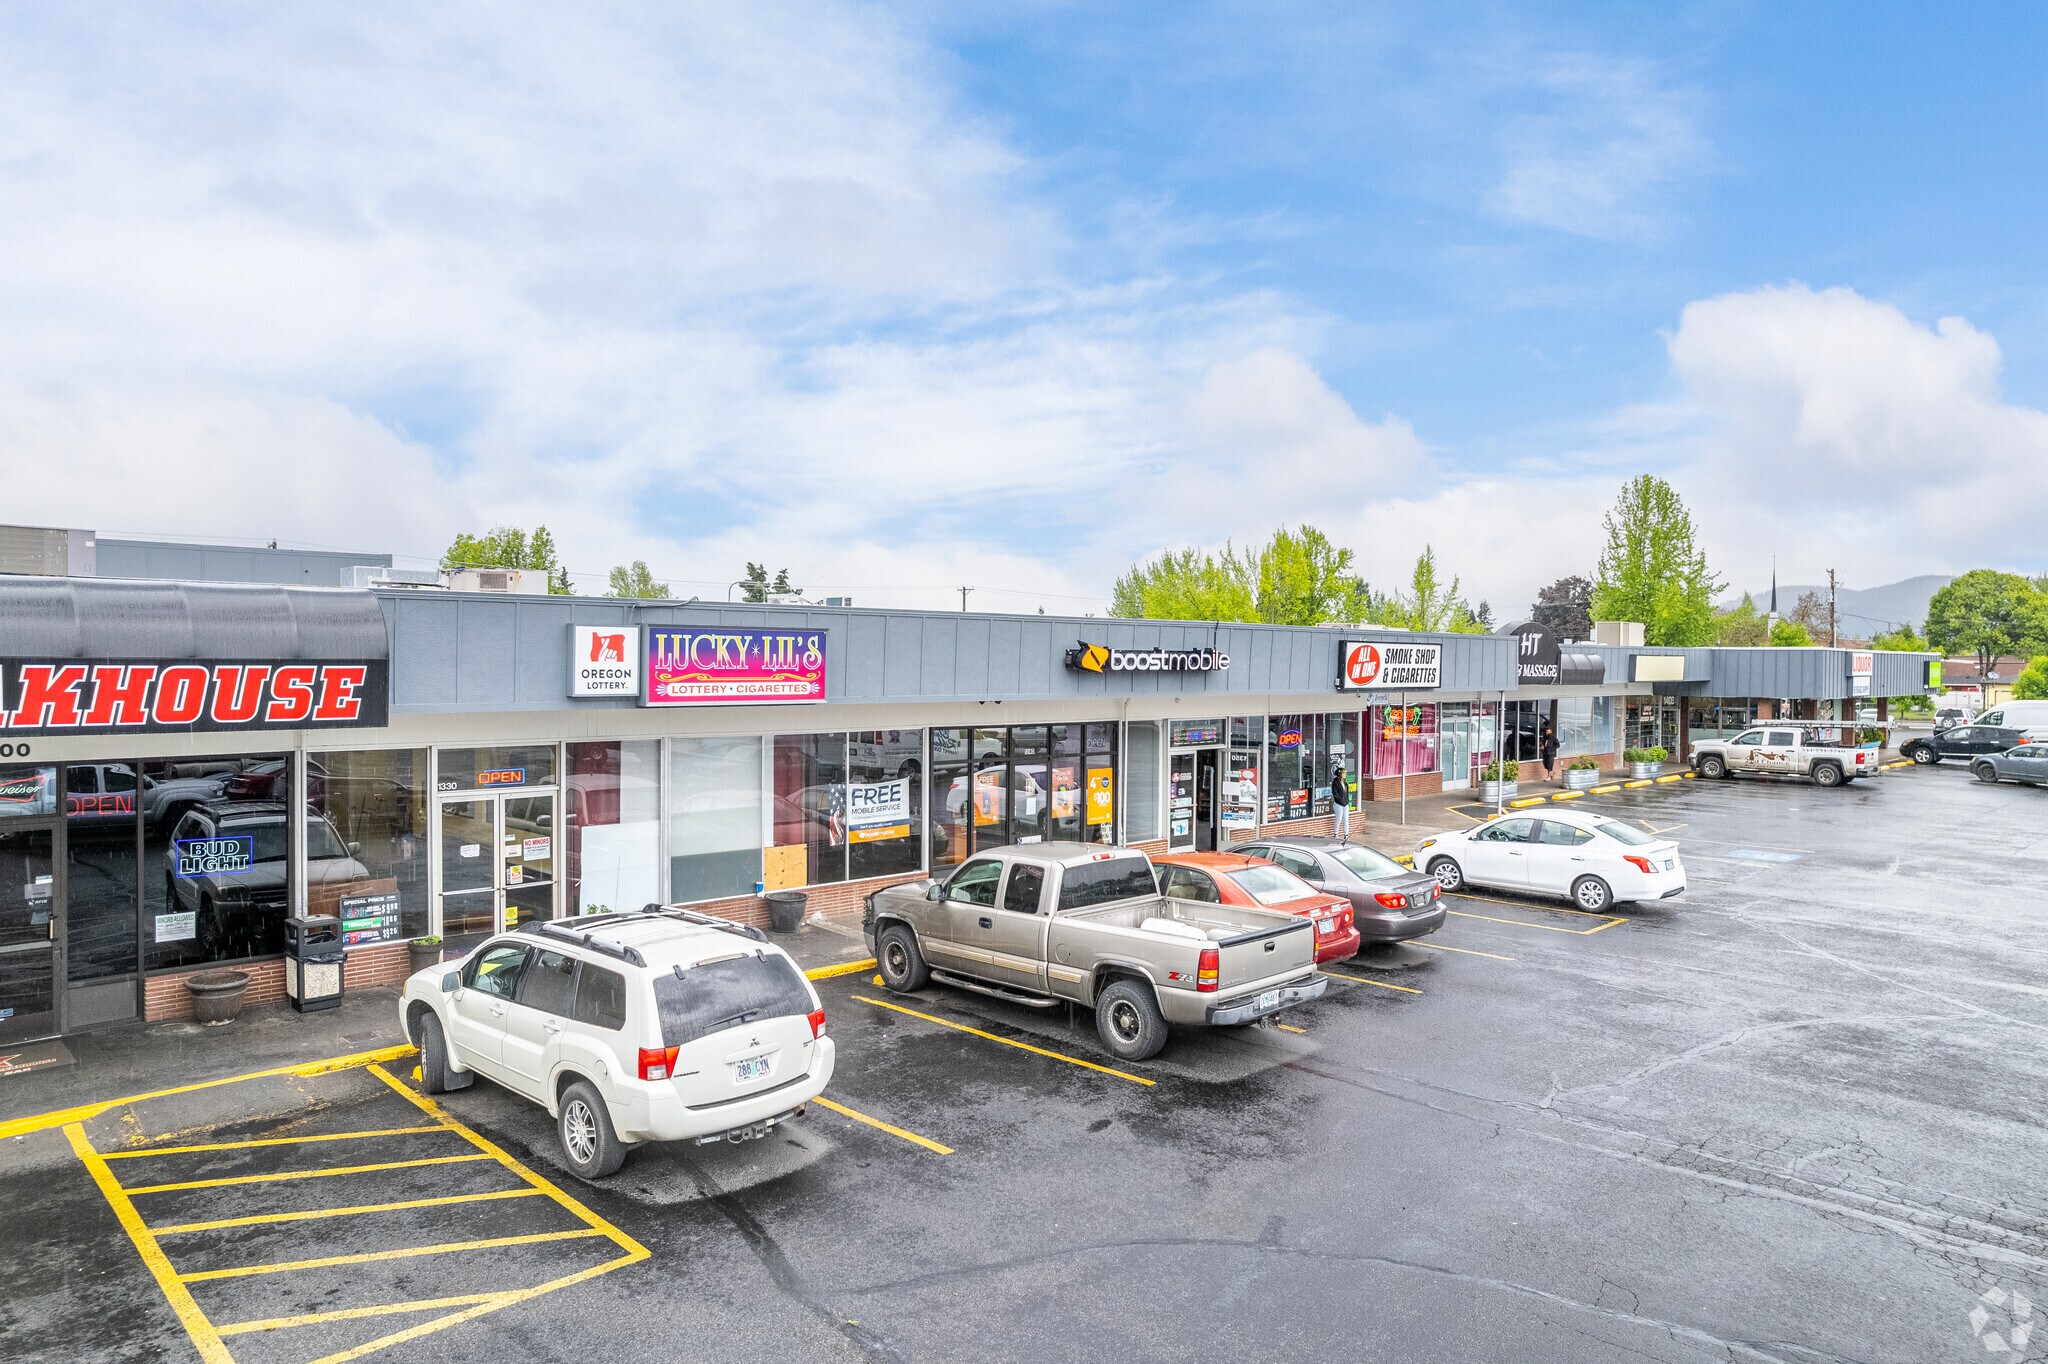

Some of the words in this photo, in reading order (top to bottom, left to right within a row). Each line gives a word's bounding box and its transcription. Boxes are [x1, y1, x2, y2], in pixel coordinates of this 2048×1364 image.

[1521, 632, 1543, 656] HT
[655, 633, 753, 672] LUCKY
[761, 635, 823, 672] LIL'S
[1357, 646, 1371, 662] ALL
[1384, 648, 1413, 665] SMOKE
[1414, 648, 1436, 664] SHOP
[1351, 663, 1361, 679] IN
[1362, 661, 1377, 678] ONE
[1523, 664, 1558, 677] MASSAGE
[1853, 656, 1872, 672] LIQUOR
[581, 669, 632, 679] OREGON
[1382, 668, 1390, 683] &
[1391, 667, 1437, 684] CIGARETTES
[587, 682, 627, 690] LOTTERY
[672, 685, 726, 694] LOTTERY
[736, 684, 808, 693] CIGARETTES
[0, 664, 368, 729] KHOUSE
[1279, 733, 1302, 745] OPEN
[478, 771, 523, 784] OPEN
[979, 775, 994, 784] FREE
[438, 782, 458, 790] 1330
[851, 783, 901, 806] FREE
[1093, 790, 1110, 804] $100
[851, 807, 875, 815] MOBILE
[875, 804, 901, 812] SERVICE
[190, 840, 240, 858] BUD
[532, 838, 550, 846] MINORS
[180, 855, 249, 875] LIGHT
[157, 915, 173, 923] MINORS
[174, 913, 195, 921] ALLOWED
[737, 1065, 752, 1078] 288
[755, 1058, 770, 1073] CYN
